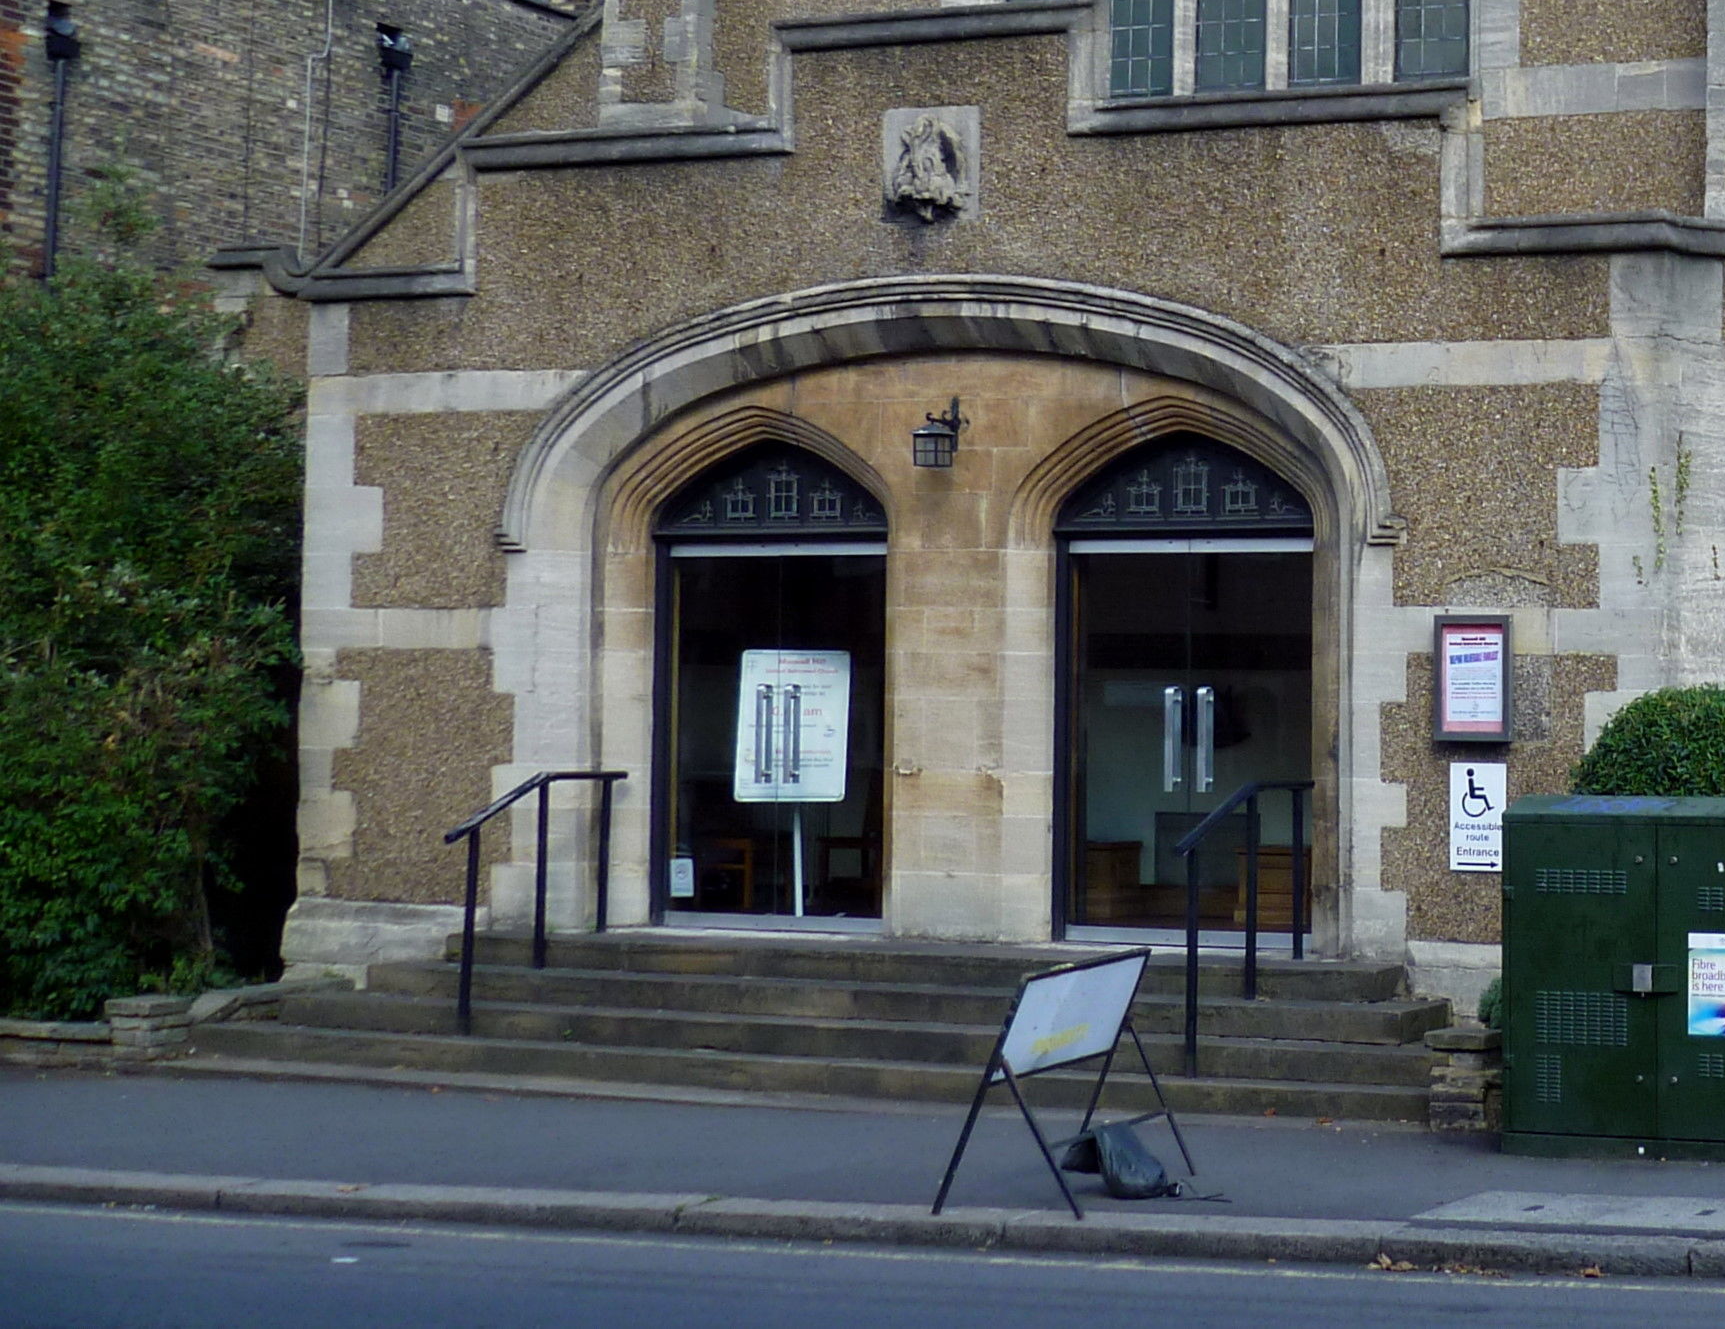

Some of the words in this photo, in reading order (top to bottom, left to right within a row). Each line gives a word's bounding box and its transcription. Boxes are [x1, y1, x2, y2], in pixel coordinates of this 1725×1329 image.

[1454, 821, 1503, 831] Accessible
[1466, 833, 1490, 842] route
[1456, 846, 1500, 857] Entrance
[1692, 958, 1716, 970] Fibre
[1692, 981, 1700, 991] is
[1701, 981, 1724, 991] here
